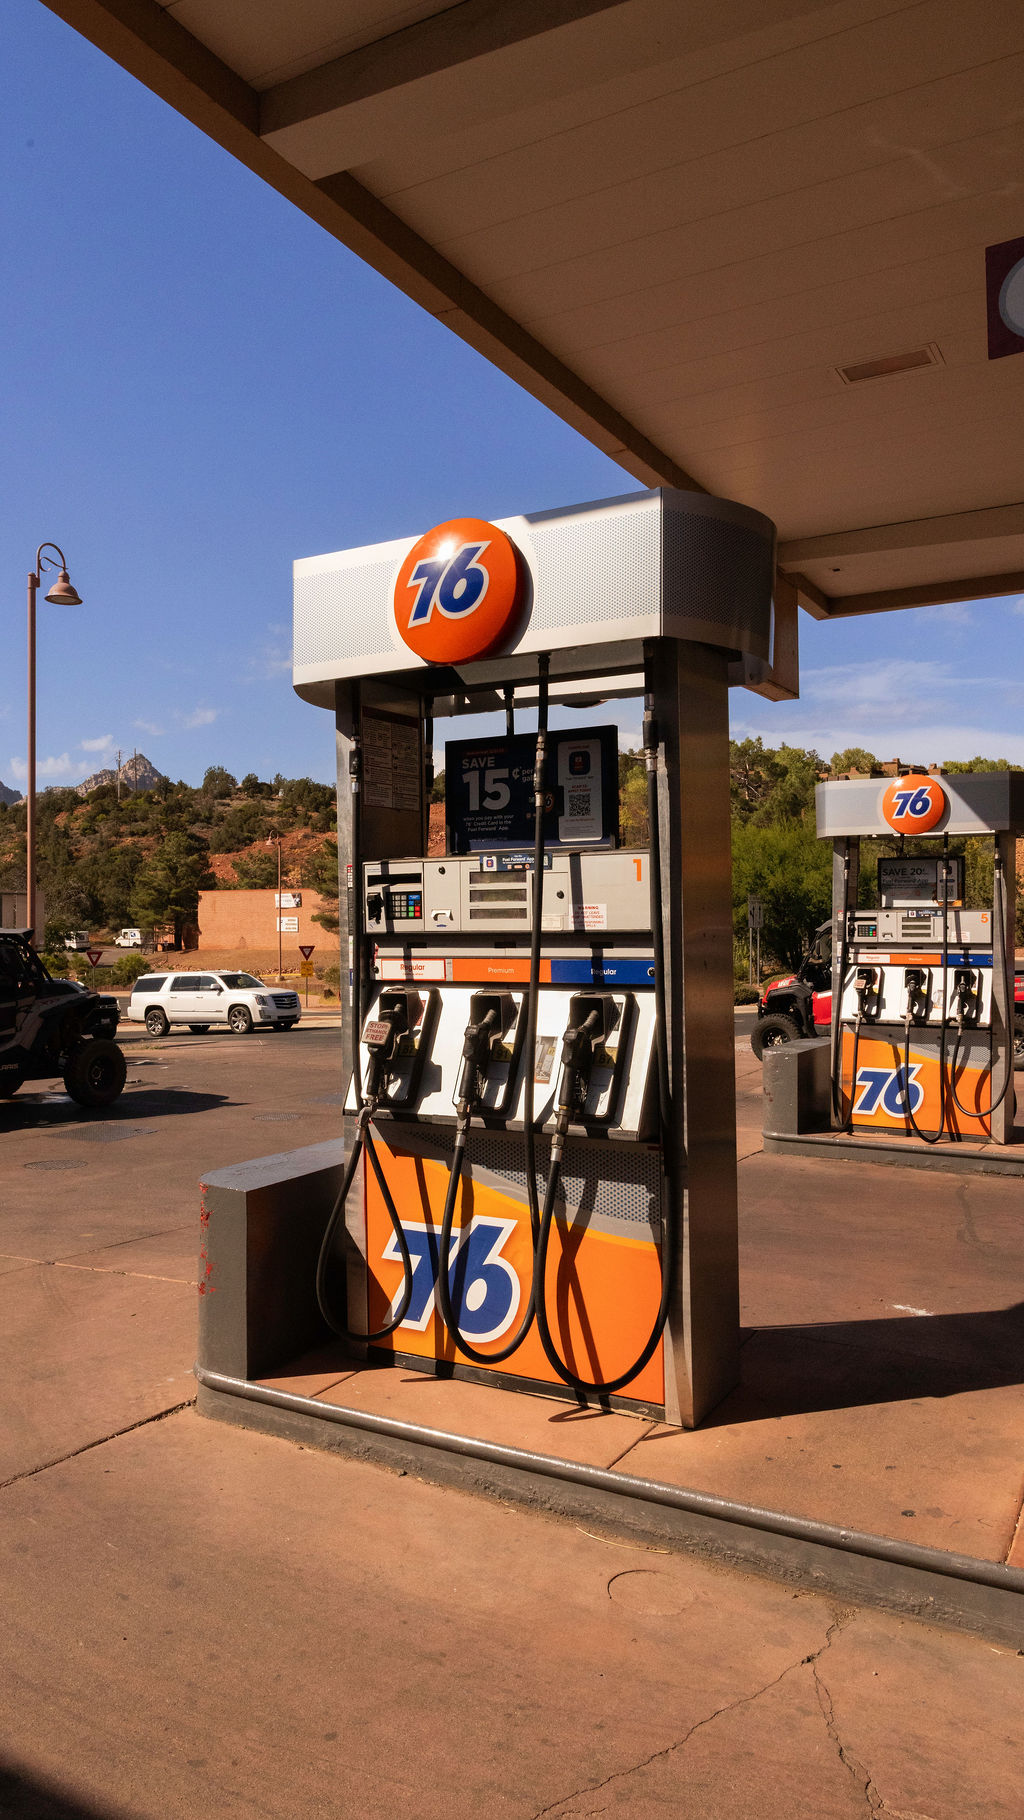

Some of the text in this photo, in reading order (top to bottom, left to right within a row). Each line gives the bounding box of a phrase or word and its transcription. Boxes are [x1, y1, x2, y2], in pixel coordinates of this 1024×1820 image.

[406, 540, 492, 629] 76
[462, 756, 496, 769] SAVE
[462, 768, 511, 811] 15
[891, 786, 932, 819] 76
[632, 858, 642, 881] 1
[882, 867, 908, 876] SAVE
[980, 913, 989, 923] 5
[400, 963, 425, 972] Regular
[590, 967, 617, 976] Regular
[850, 1062, 924, 1118] 76
[381, 1215, 520, 1343] 76
